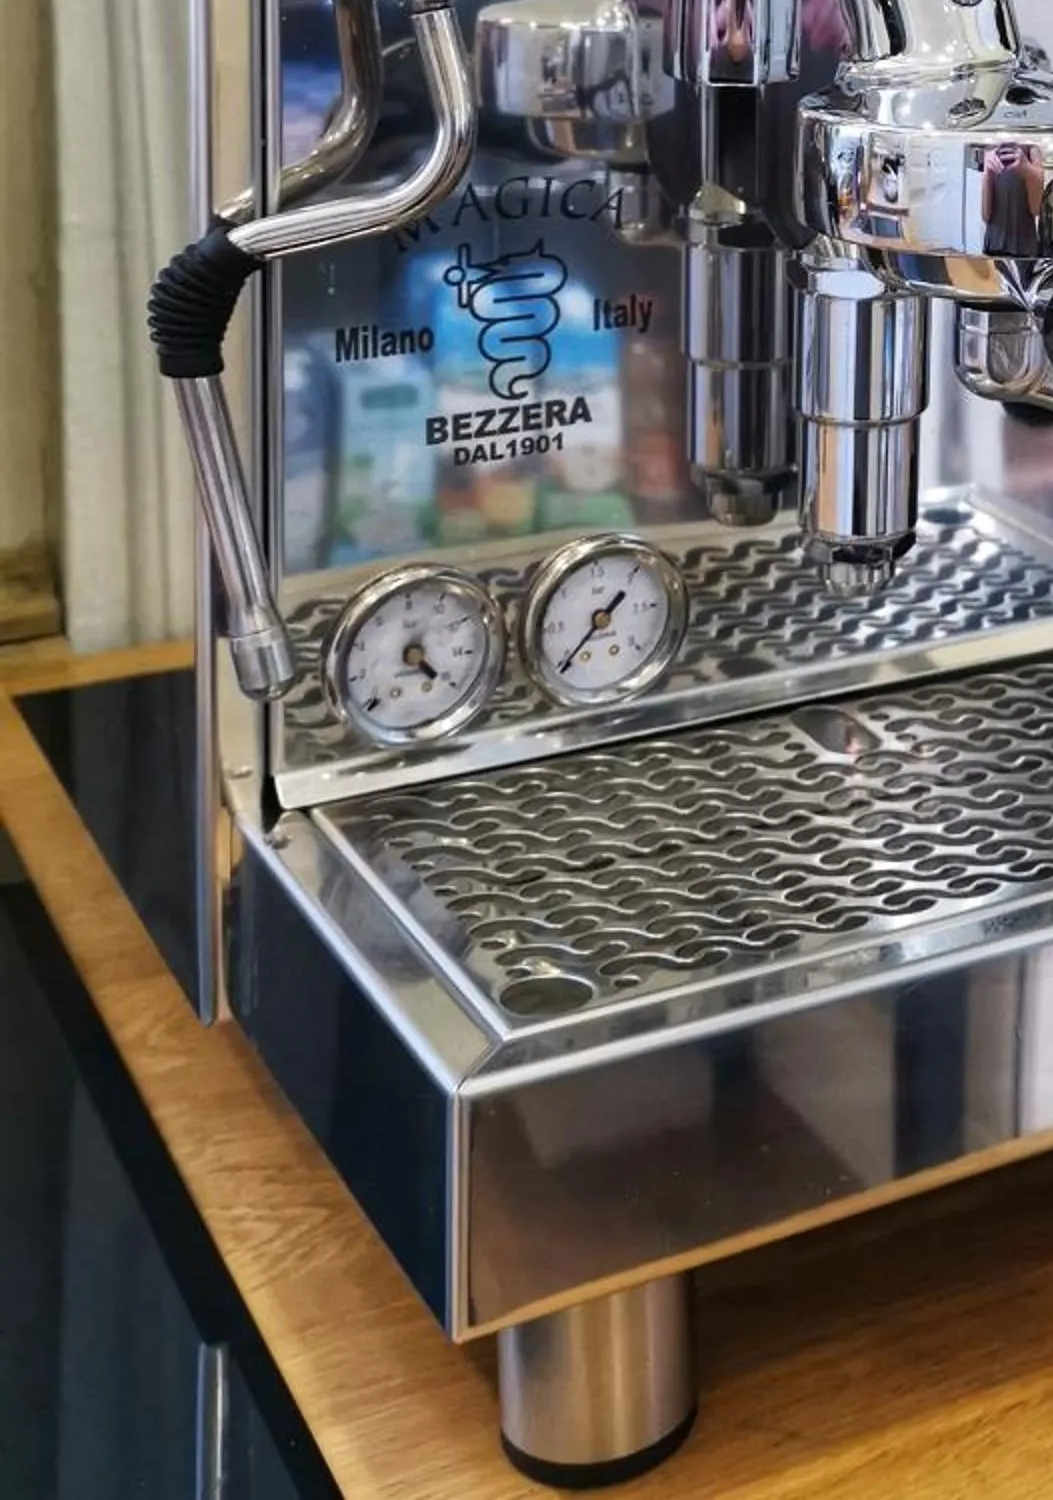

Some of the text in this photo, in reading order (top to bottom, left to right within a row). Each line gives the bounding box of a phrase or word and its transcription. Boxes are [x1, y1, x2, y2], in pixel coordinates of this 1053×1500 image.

[594, 293, 653, 334] Italy
[335, 324, 435, 363] Milano
[425, 396, 592, 445] BEZZERA
